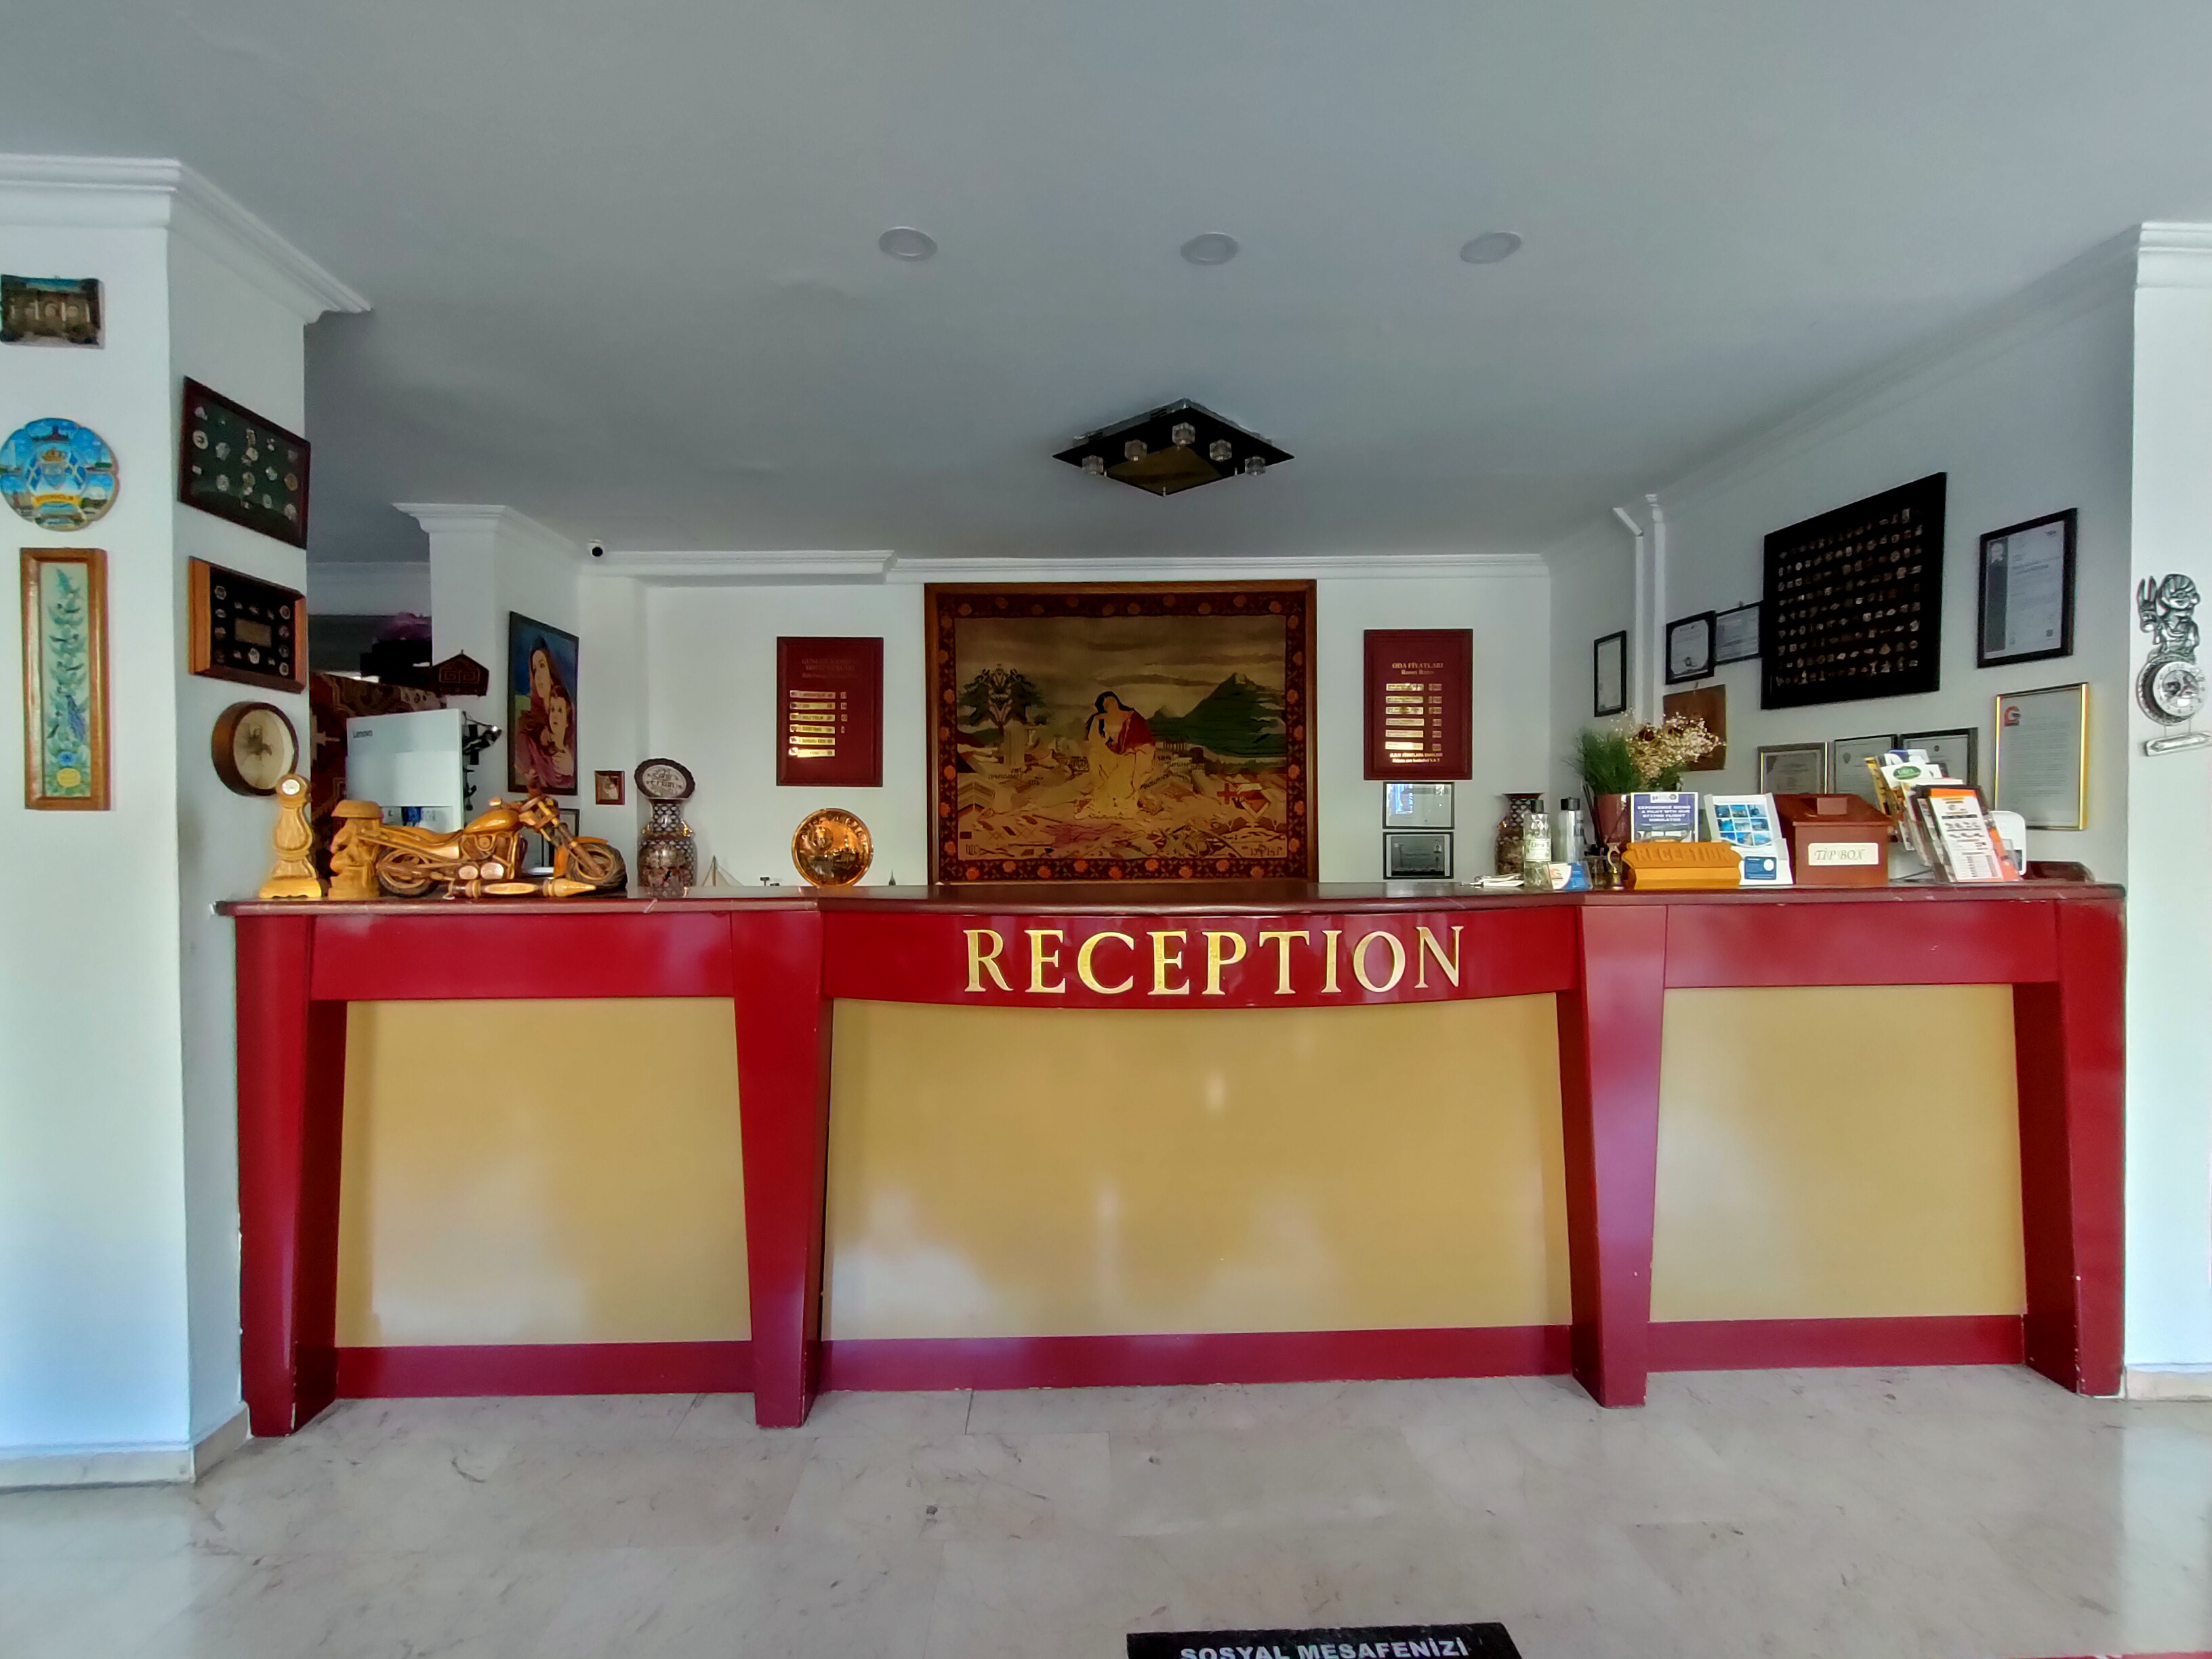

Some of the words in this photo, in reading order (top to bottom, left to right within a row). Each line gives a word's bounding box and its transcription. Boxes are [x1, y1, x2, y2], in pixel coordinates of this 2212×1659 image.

[353, 730, 373, 738] Lenovo
[1635, 846, 1730, 862] RECEPTION
[1838, 849, 1865, 861] BOX
[963, 926, 1464, 996] RECEPTION
[1180, 1645, 1290, 1659] SOSYAL
[1297, 1637, 1469, 1659] MESAFENİZİ
